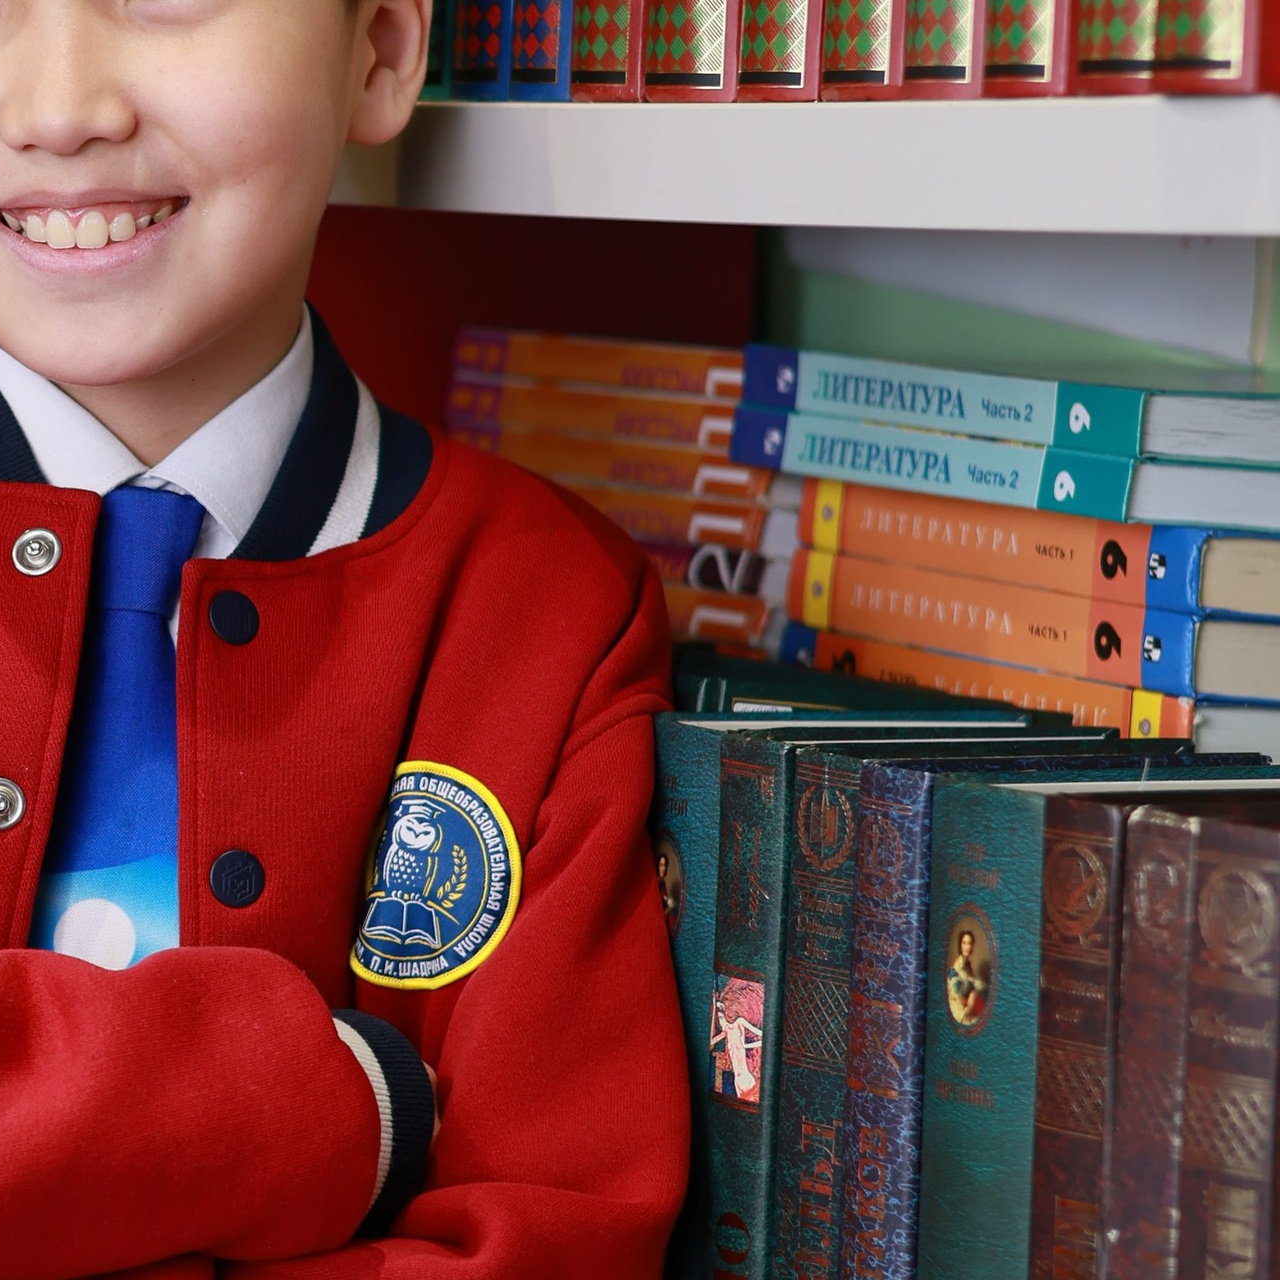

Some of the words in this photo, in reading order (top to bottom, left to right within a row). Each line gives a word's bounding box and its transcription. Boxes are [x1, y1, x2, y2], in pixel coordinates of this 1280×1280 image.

[812, 371, 967, 420] ЛИТЕРАТУРА
[981, 398, 1021, 422] Часть
[1024, 404, 1034, 422] 2
[1069, 401, 1091, 434] 6
[798, 432, 952, 484] ЛИТЕРАТУРА
[967, 463, 1007, 489] Часть
[1010, 471, 1019, 489] 2
[1053, 470, 1076, 502] 6
[859, 506, 1020, 557] ЛИТЕРАТУРА
[1034, 542, 1065, 561] ЧАСТЬ
[1068, 548, 1075, 561] 1
[1099, 539, 1128, 580] 6
[849, 583, 1014, 636] ЛИТЕРАТУРА
[1028, 623, 1059, 642] ЧАСТЬ
[1062, 631, 1068, 642] 1
[1094, 620, 1122, 661] 6
[419, 776, 507, 912] ОБЩЕОБРАЗОВАТЕЛЬНАЯ
[453, 914, 496, 959] ШКОЛА
